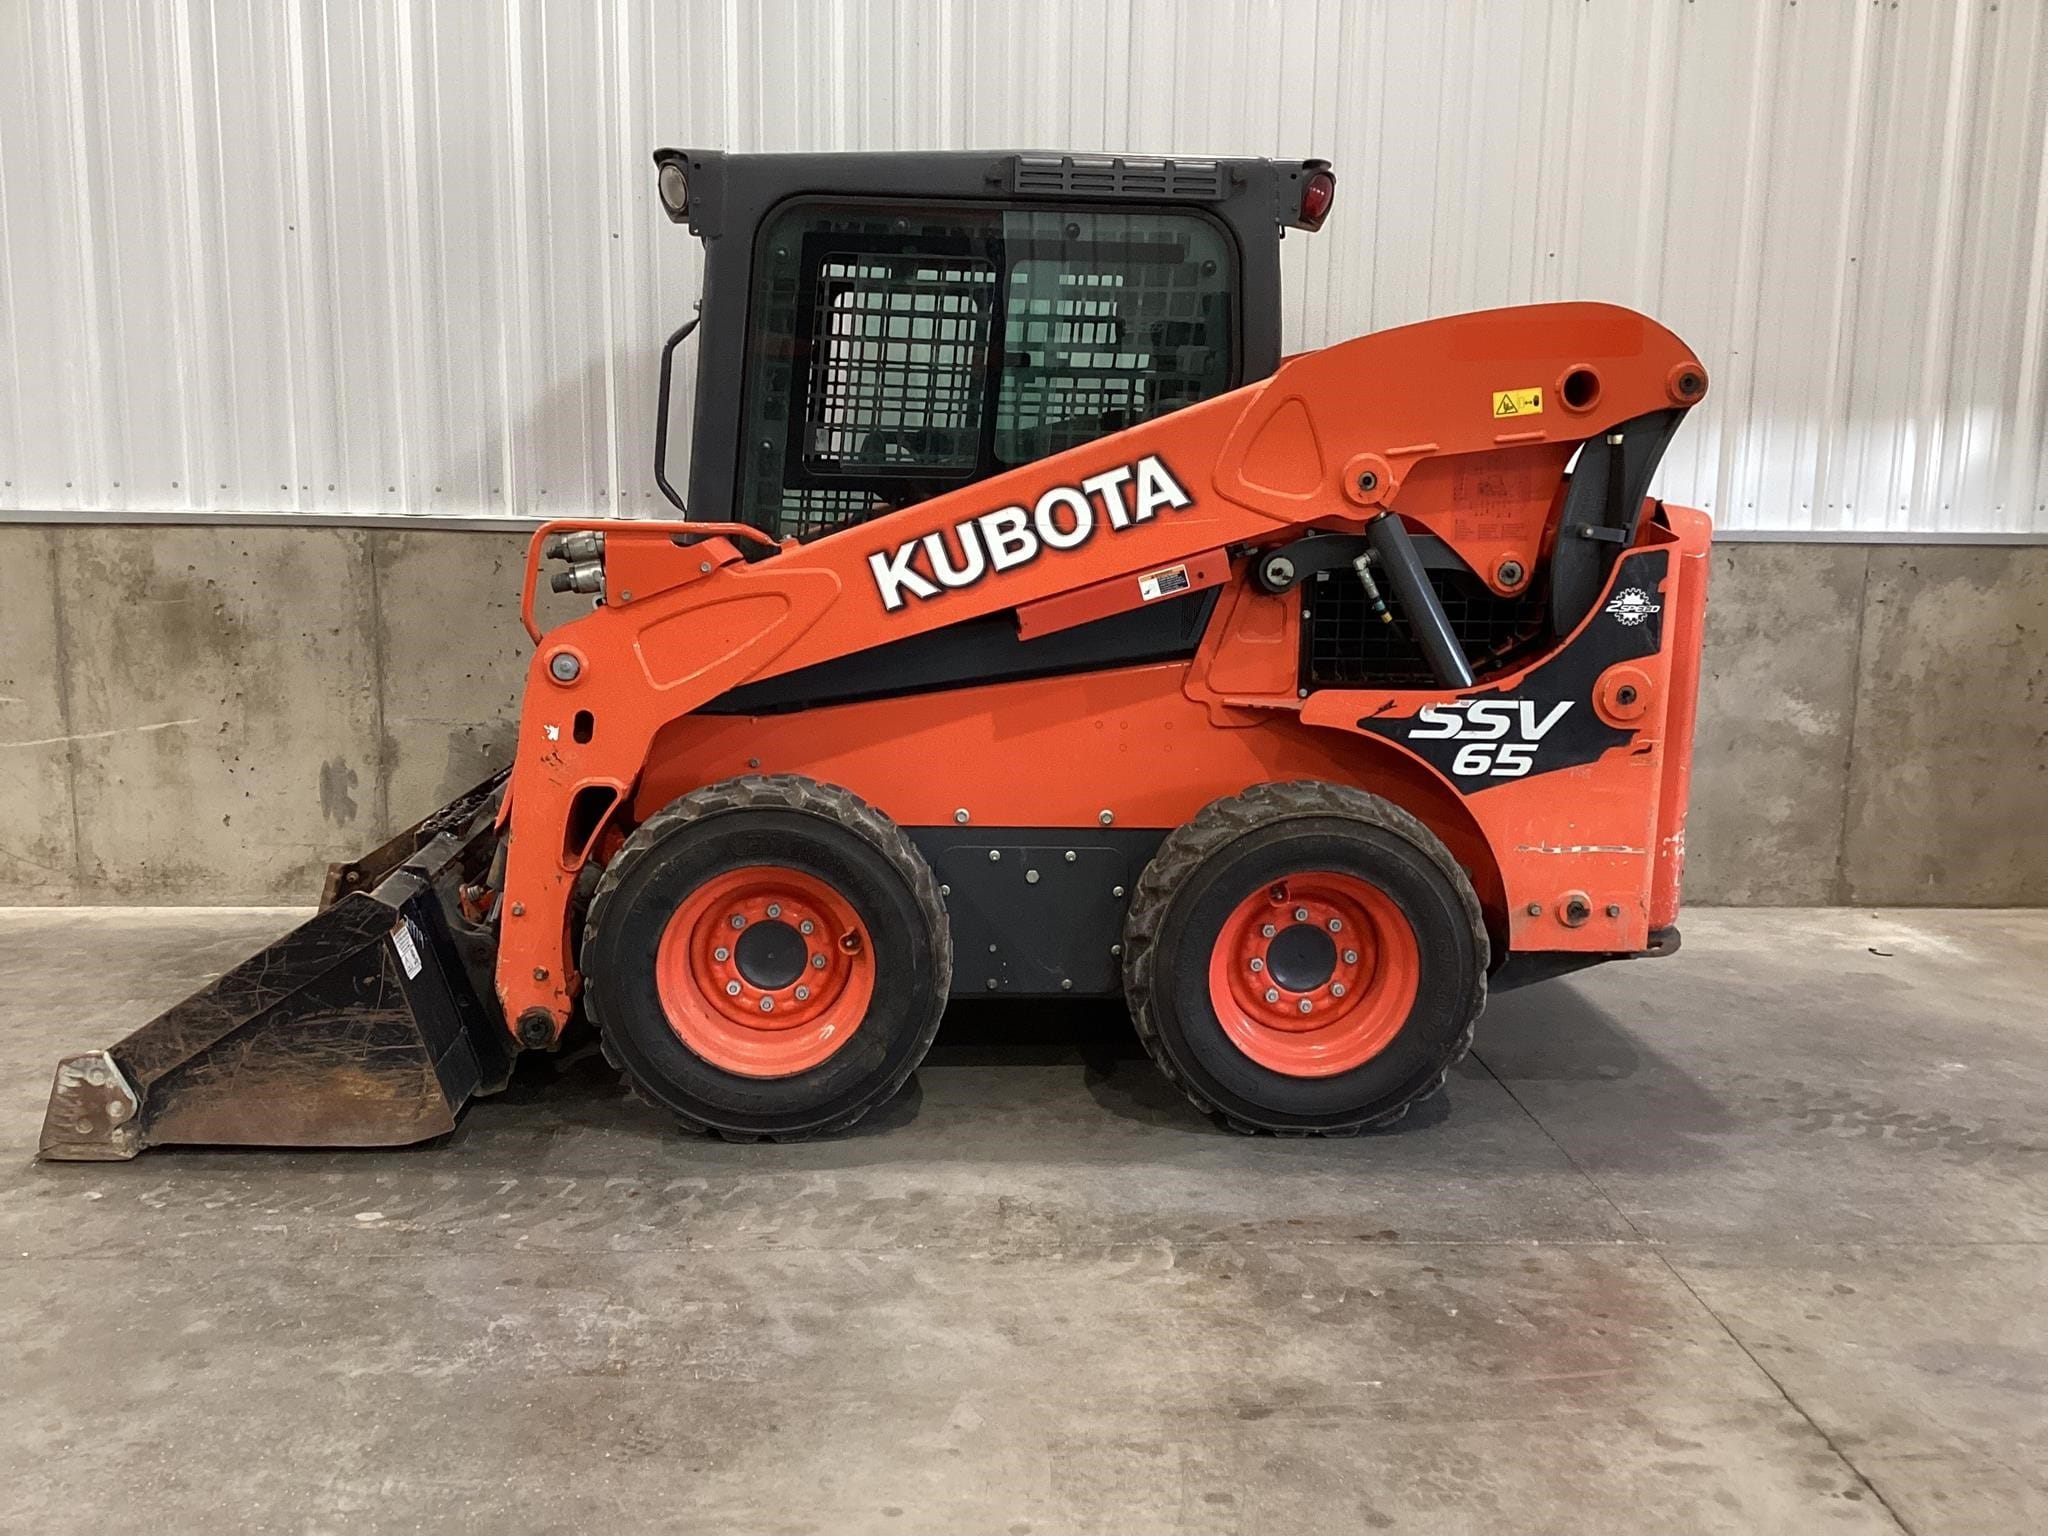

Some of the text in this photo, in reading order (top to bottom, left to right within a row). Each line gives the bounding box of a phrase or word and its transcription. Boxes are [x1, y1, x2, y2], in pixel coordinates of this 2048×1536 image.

[868, 455, 1192, 611] KUBOTA
[1408, 699, 1576, 741] SSV
[1452, 743, 1539, 776] 65
